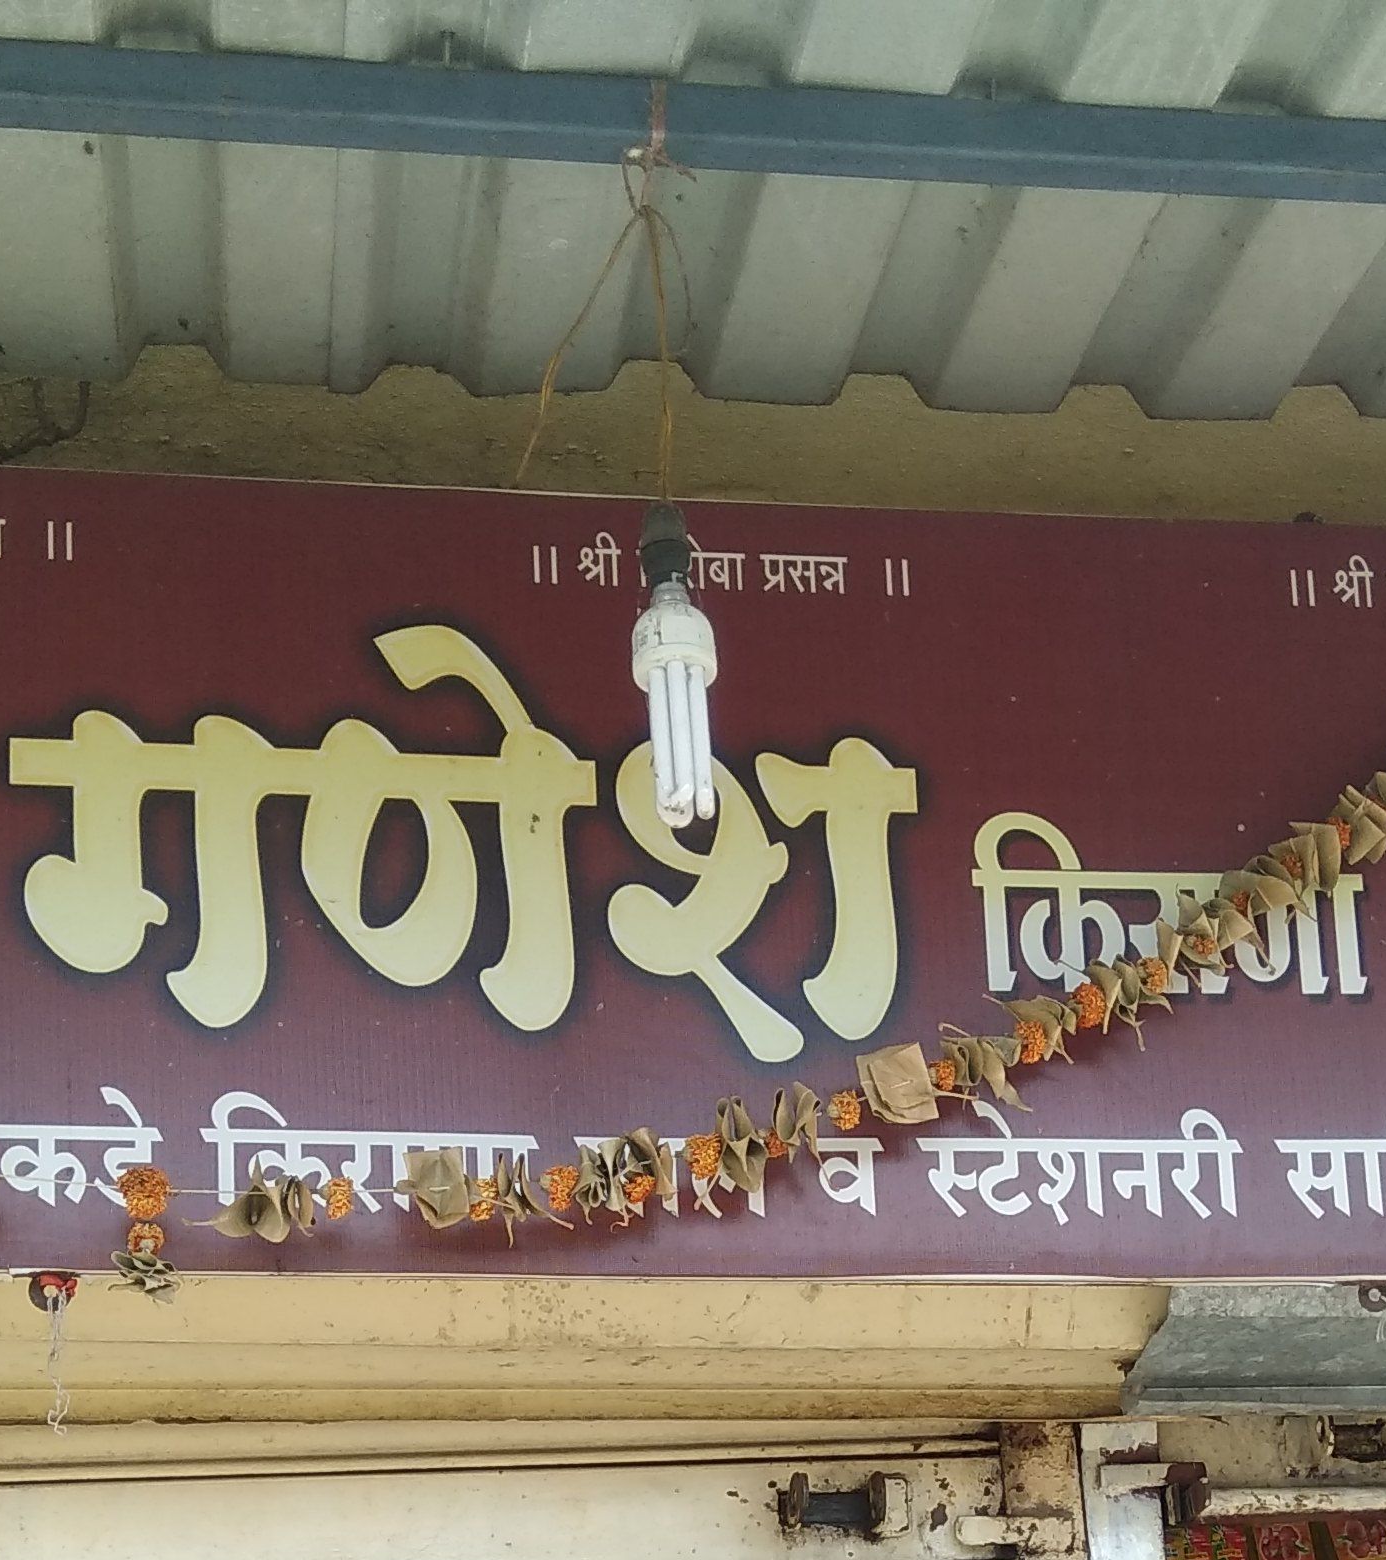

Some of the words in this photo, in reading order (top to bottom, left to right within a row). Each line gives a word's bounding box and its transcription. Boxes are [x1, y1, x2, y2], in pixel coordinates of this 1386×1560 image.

[576, 530, 622, 588] श्री
[759, 552, 848, 594] प्रसन्न
[1332, 554, 1375, 609] श्री
[9, 624, 917, 1062] गणेश
[916, 1100, 1243, 1226] स्टेशनरी
